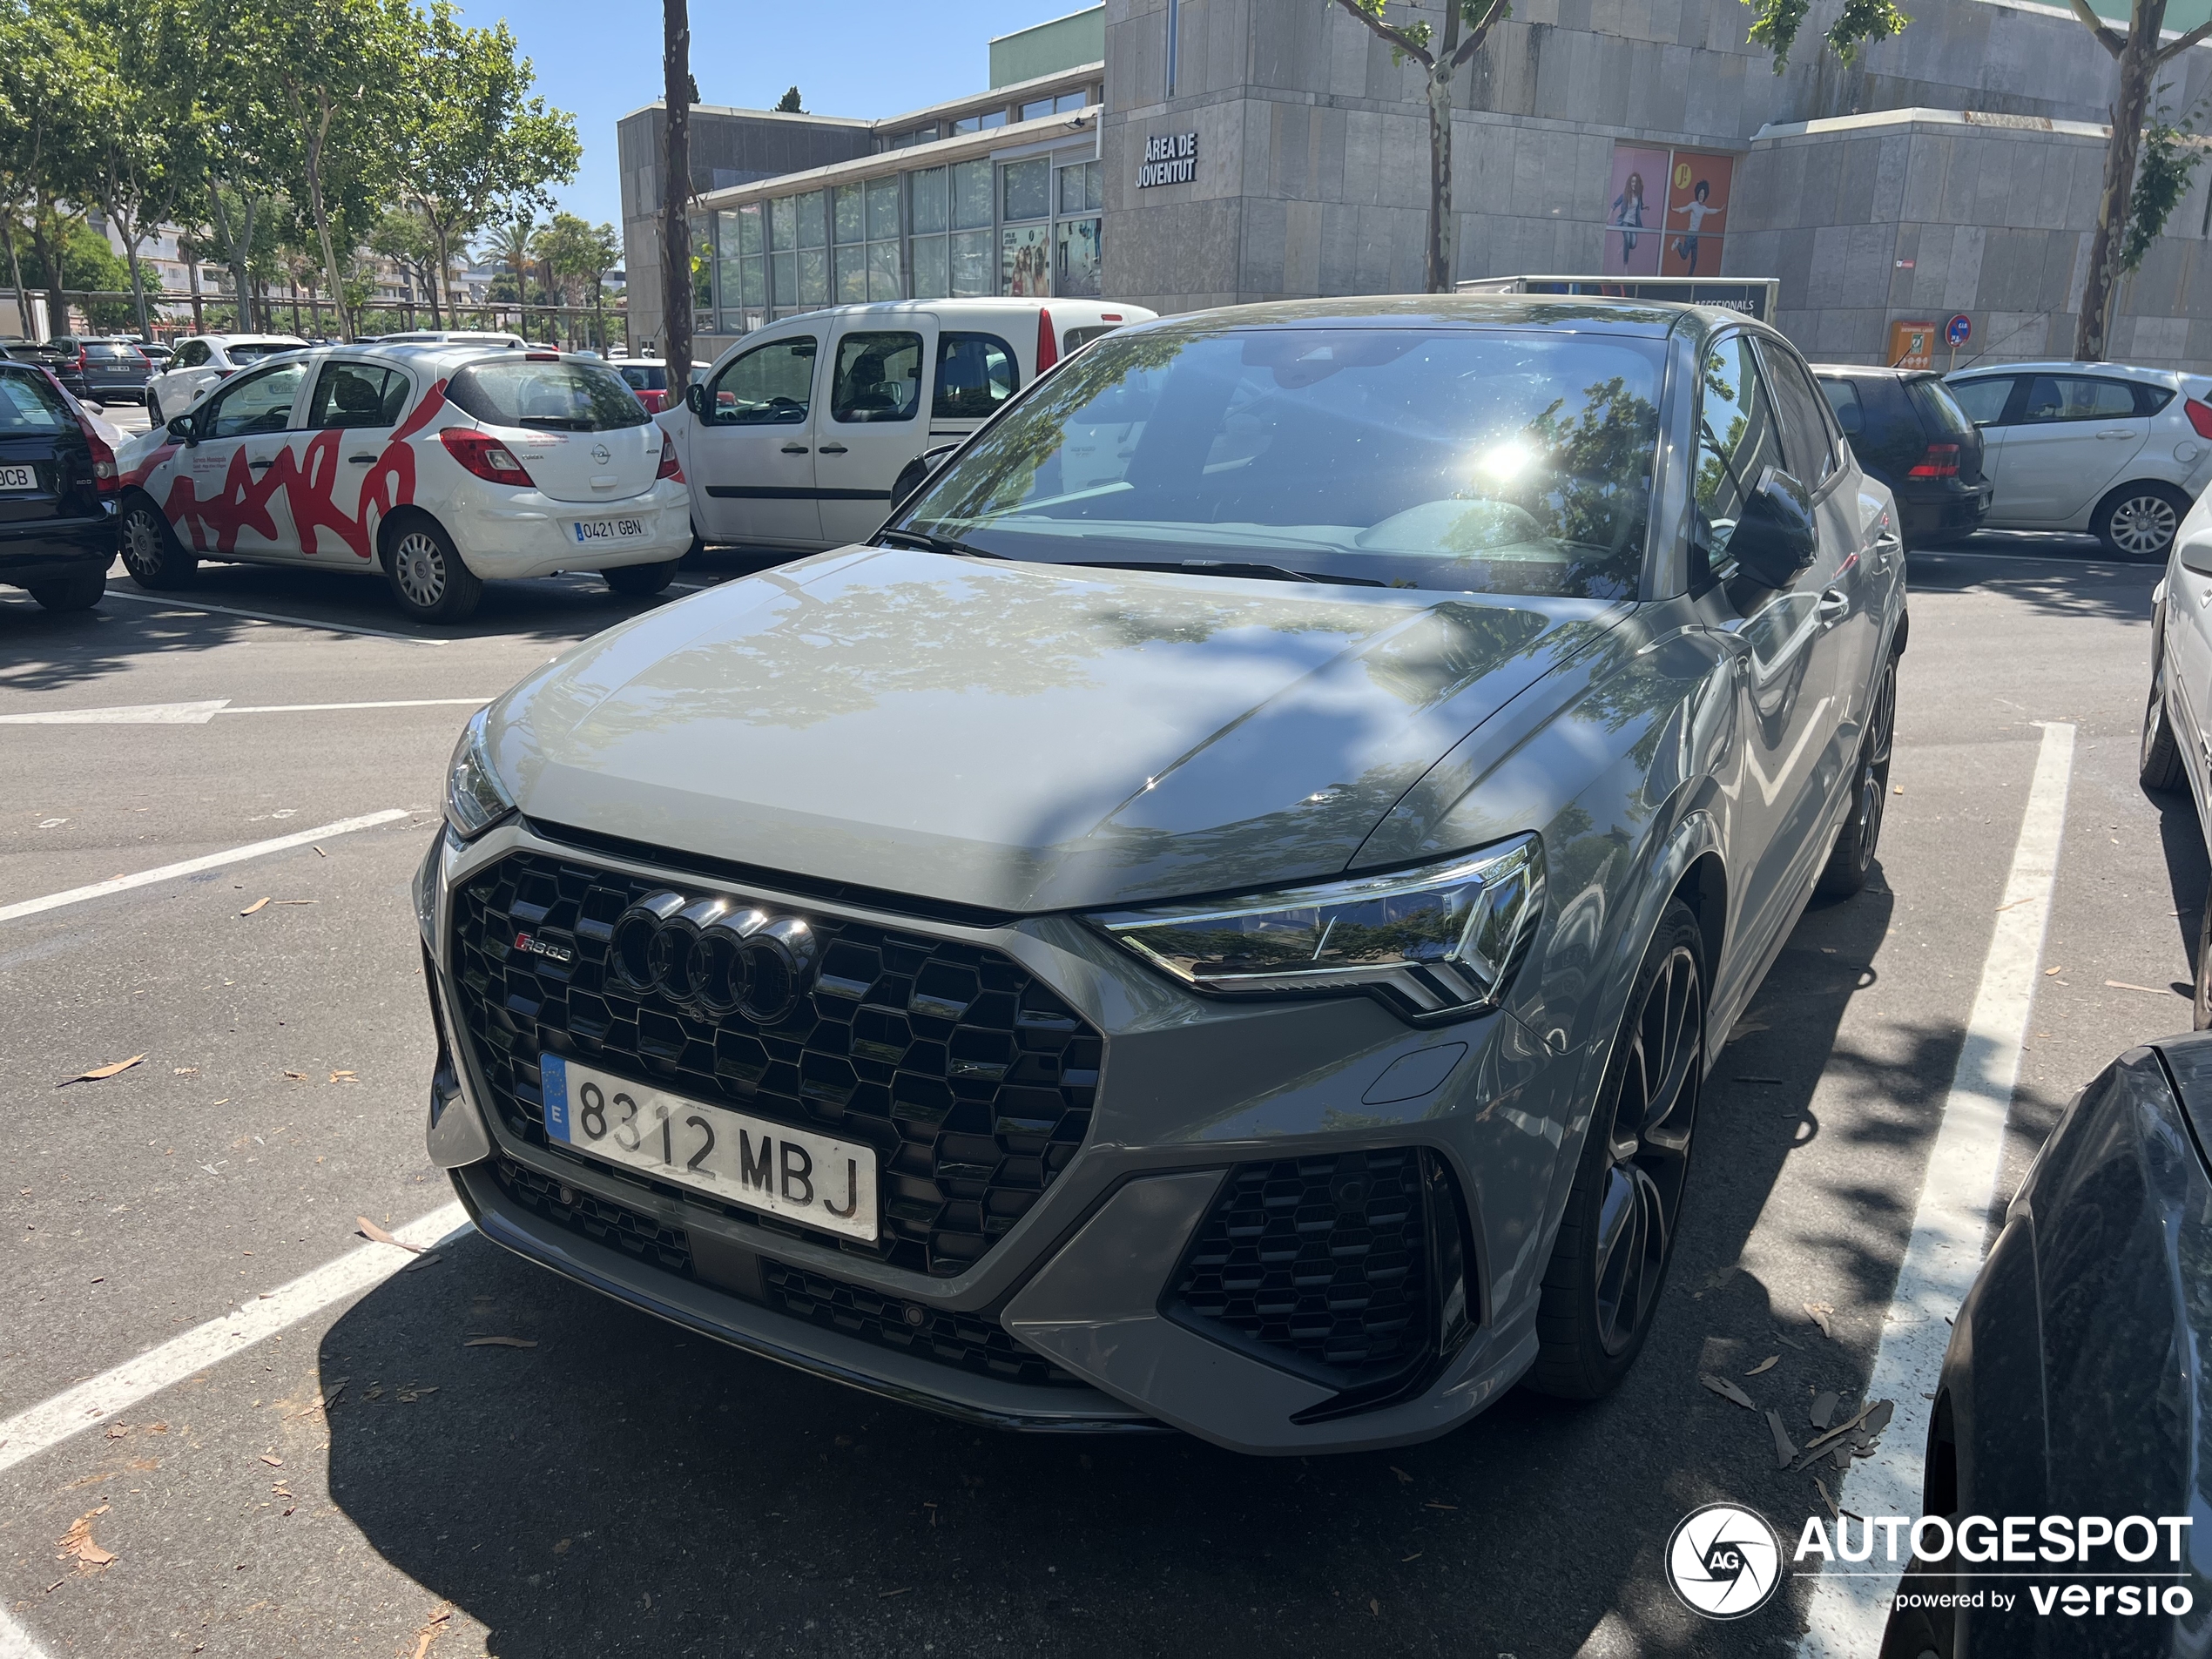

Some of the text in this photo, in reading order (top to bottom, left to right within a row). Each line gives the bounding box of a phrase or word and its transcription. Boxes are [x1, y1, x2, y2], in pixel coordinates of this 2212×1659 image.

[1178, 132, 1195, 157] DE
[1136, 158, 1195, 188] JOVENTUT
[583, 519, 642, 538] 0421 GBN
[552, 1105, 563, 1123] E
[580, 1082, 858, 1219] 8312 MBJ
